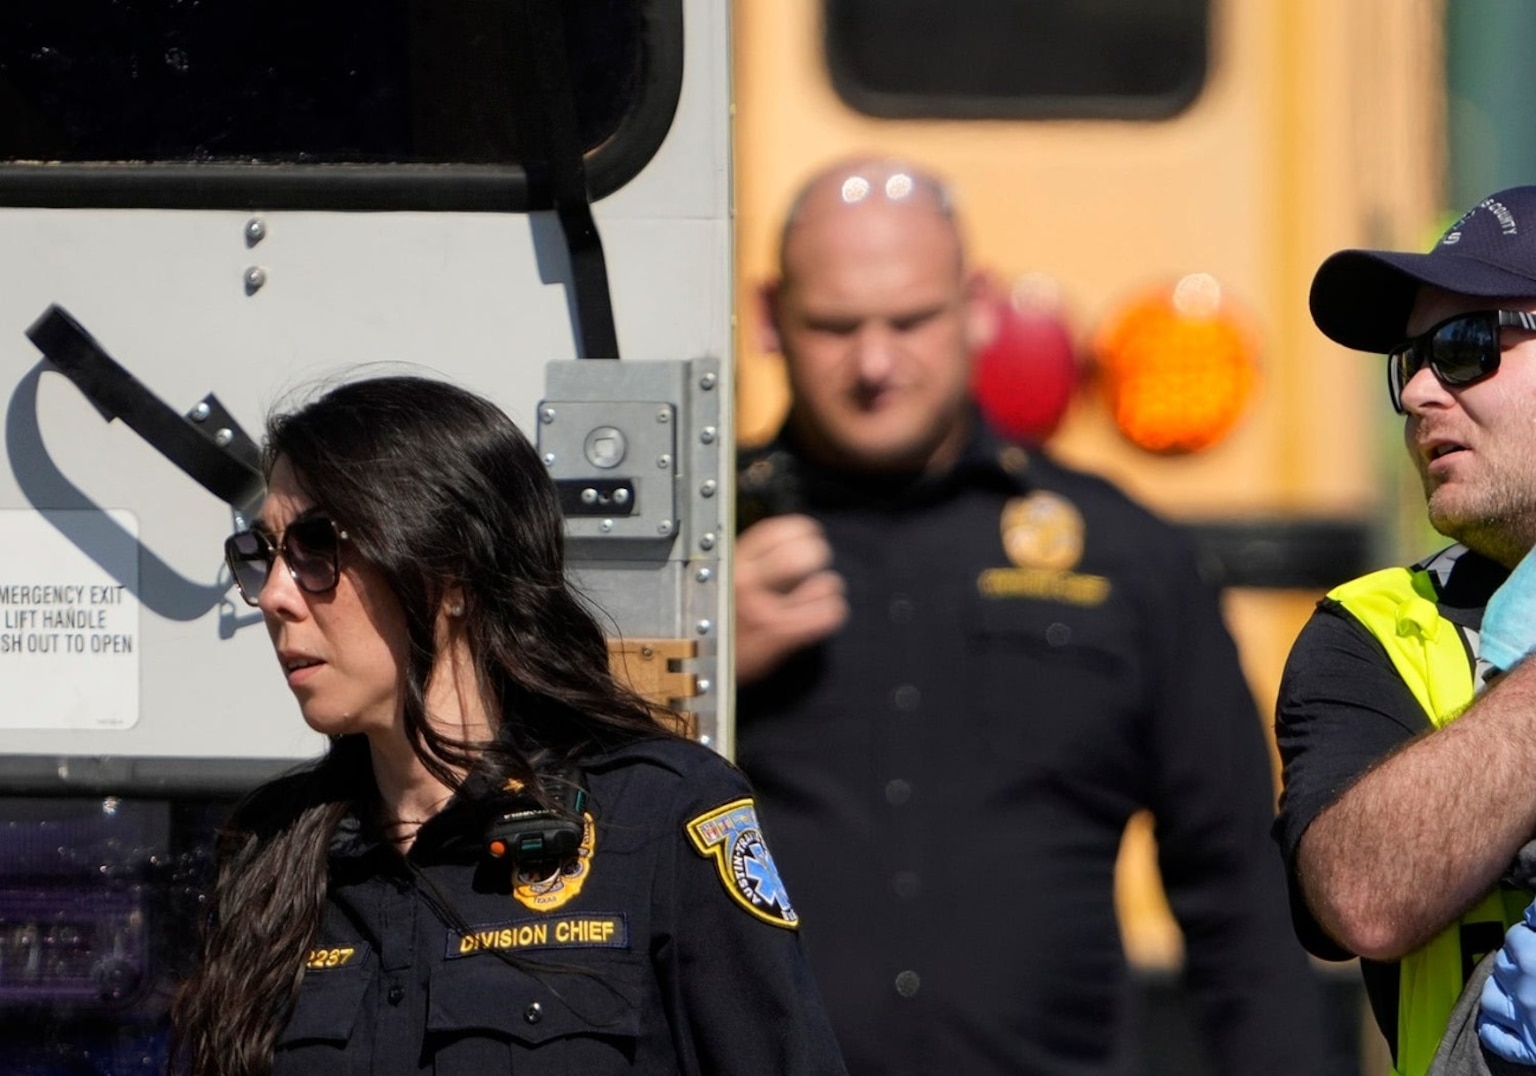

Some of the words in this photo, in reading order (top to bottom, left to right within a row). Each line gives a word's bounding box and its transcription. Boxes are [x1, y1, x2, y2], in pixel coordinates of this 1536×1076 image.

[90, 585, 125, 604] EXIT
[5, 610, 37, 629] LIFT
[43, 610, 107, 629] HANDLE
[0, 633, 22, 653] SH
[27, 633, 59, 653] OUT
[65, 633, 85, 653] TO
[90, 633, 133, 653] OPEN
[460, 924, 547, 953] DIVISION
[555, 921, 614, 942] CHIEF
